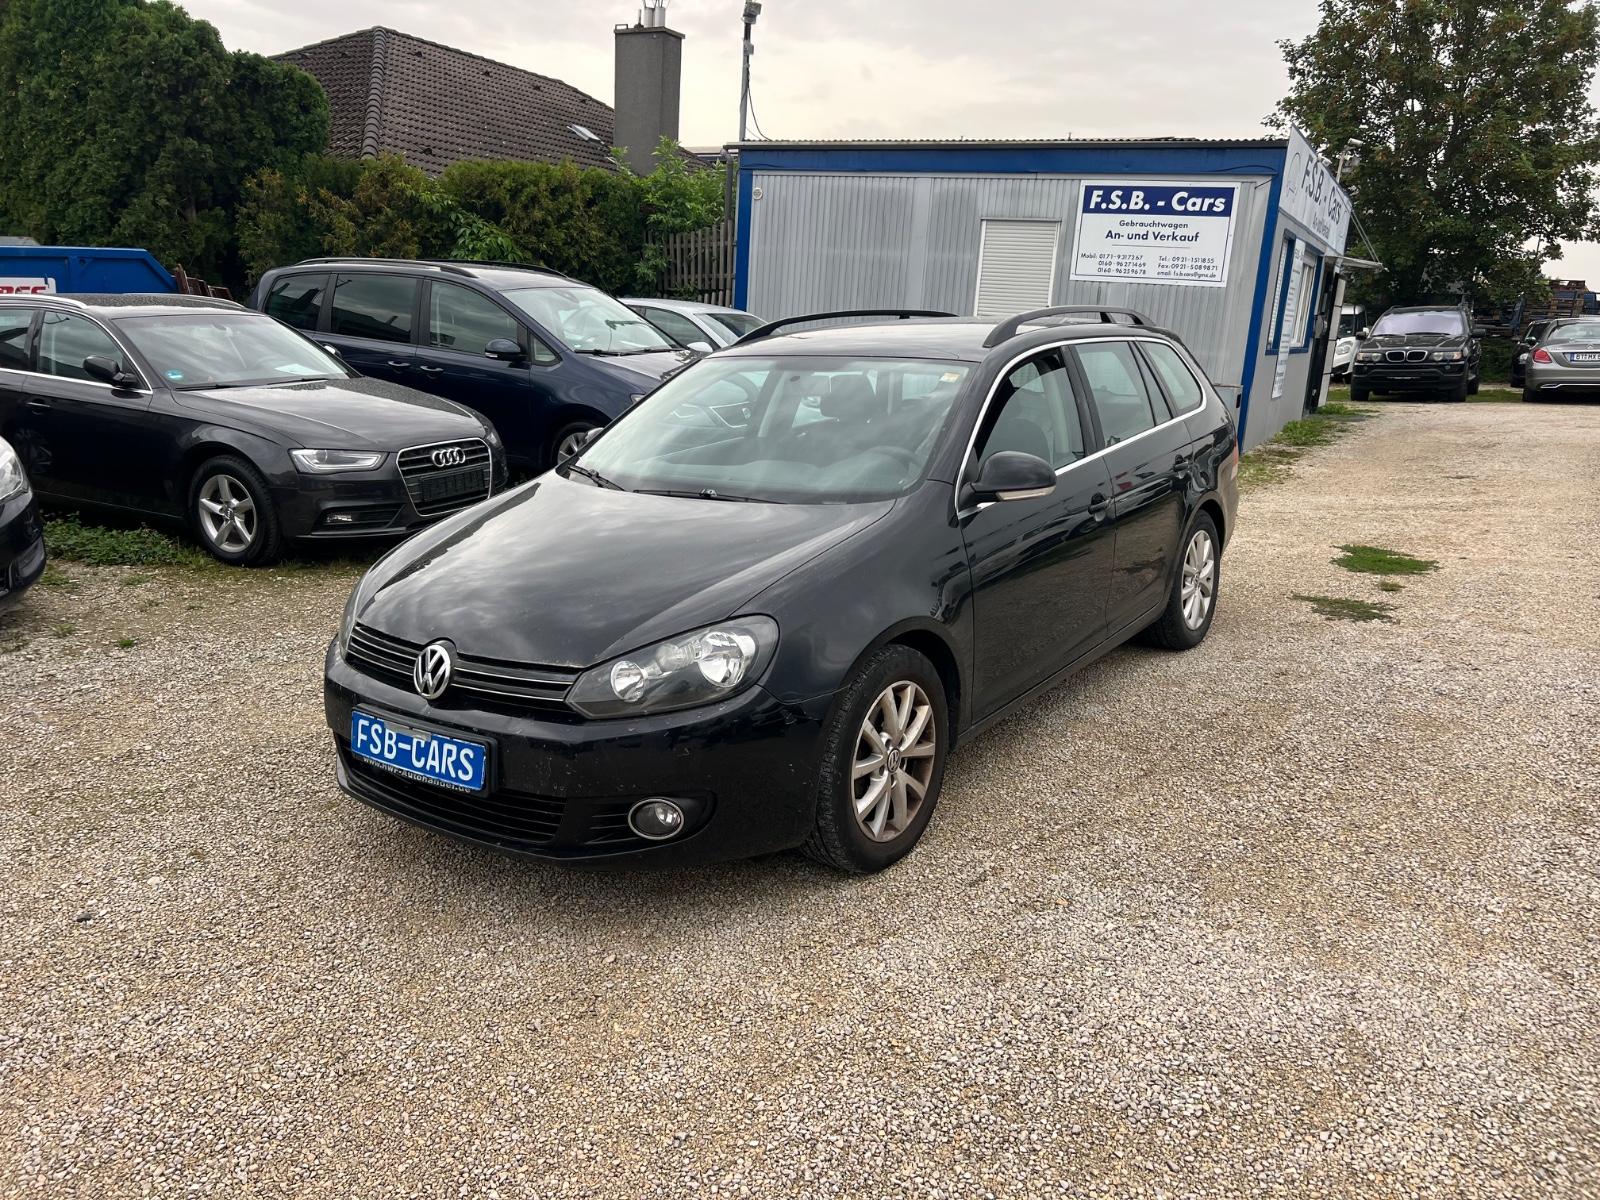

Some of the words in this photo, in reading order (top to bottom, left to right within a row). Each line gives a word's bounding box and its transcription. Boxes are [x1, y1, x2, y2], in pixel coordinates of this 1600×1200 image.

[1089, 190, 1150, 211] F.S.B.
[1171, 191, 1226, 212] Cars
[1119, 220, 1189, 229] Gebrauchtwagen
[1105, 230, 1124, 240] An-
[1127, 231, 1149, 241] und
[1152, 231, 1200, 242] Verkauf
[357, 718, 474, 781] FSB-CARS
